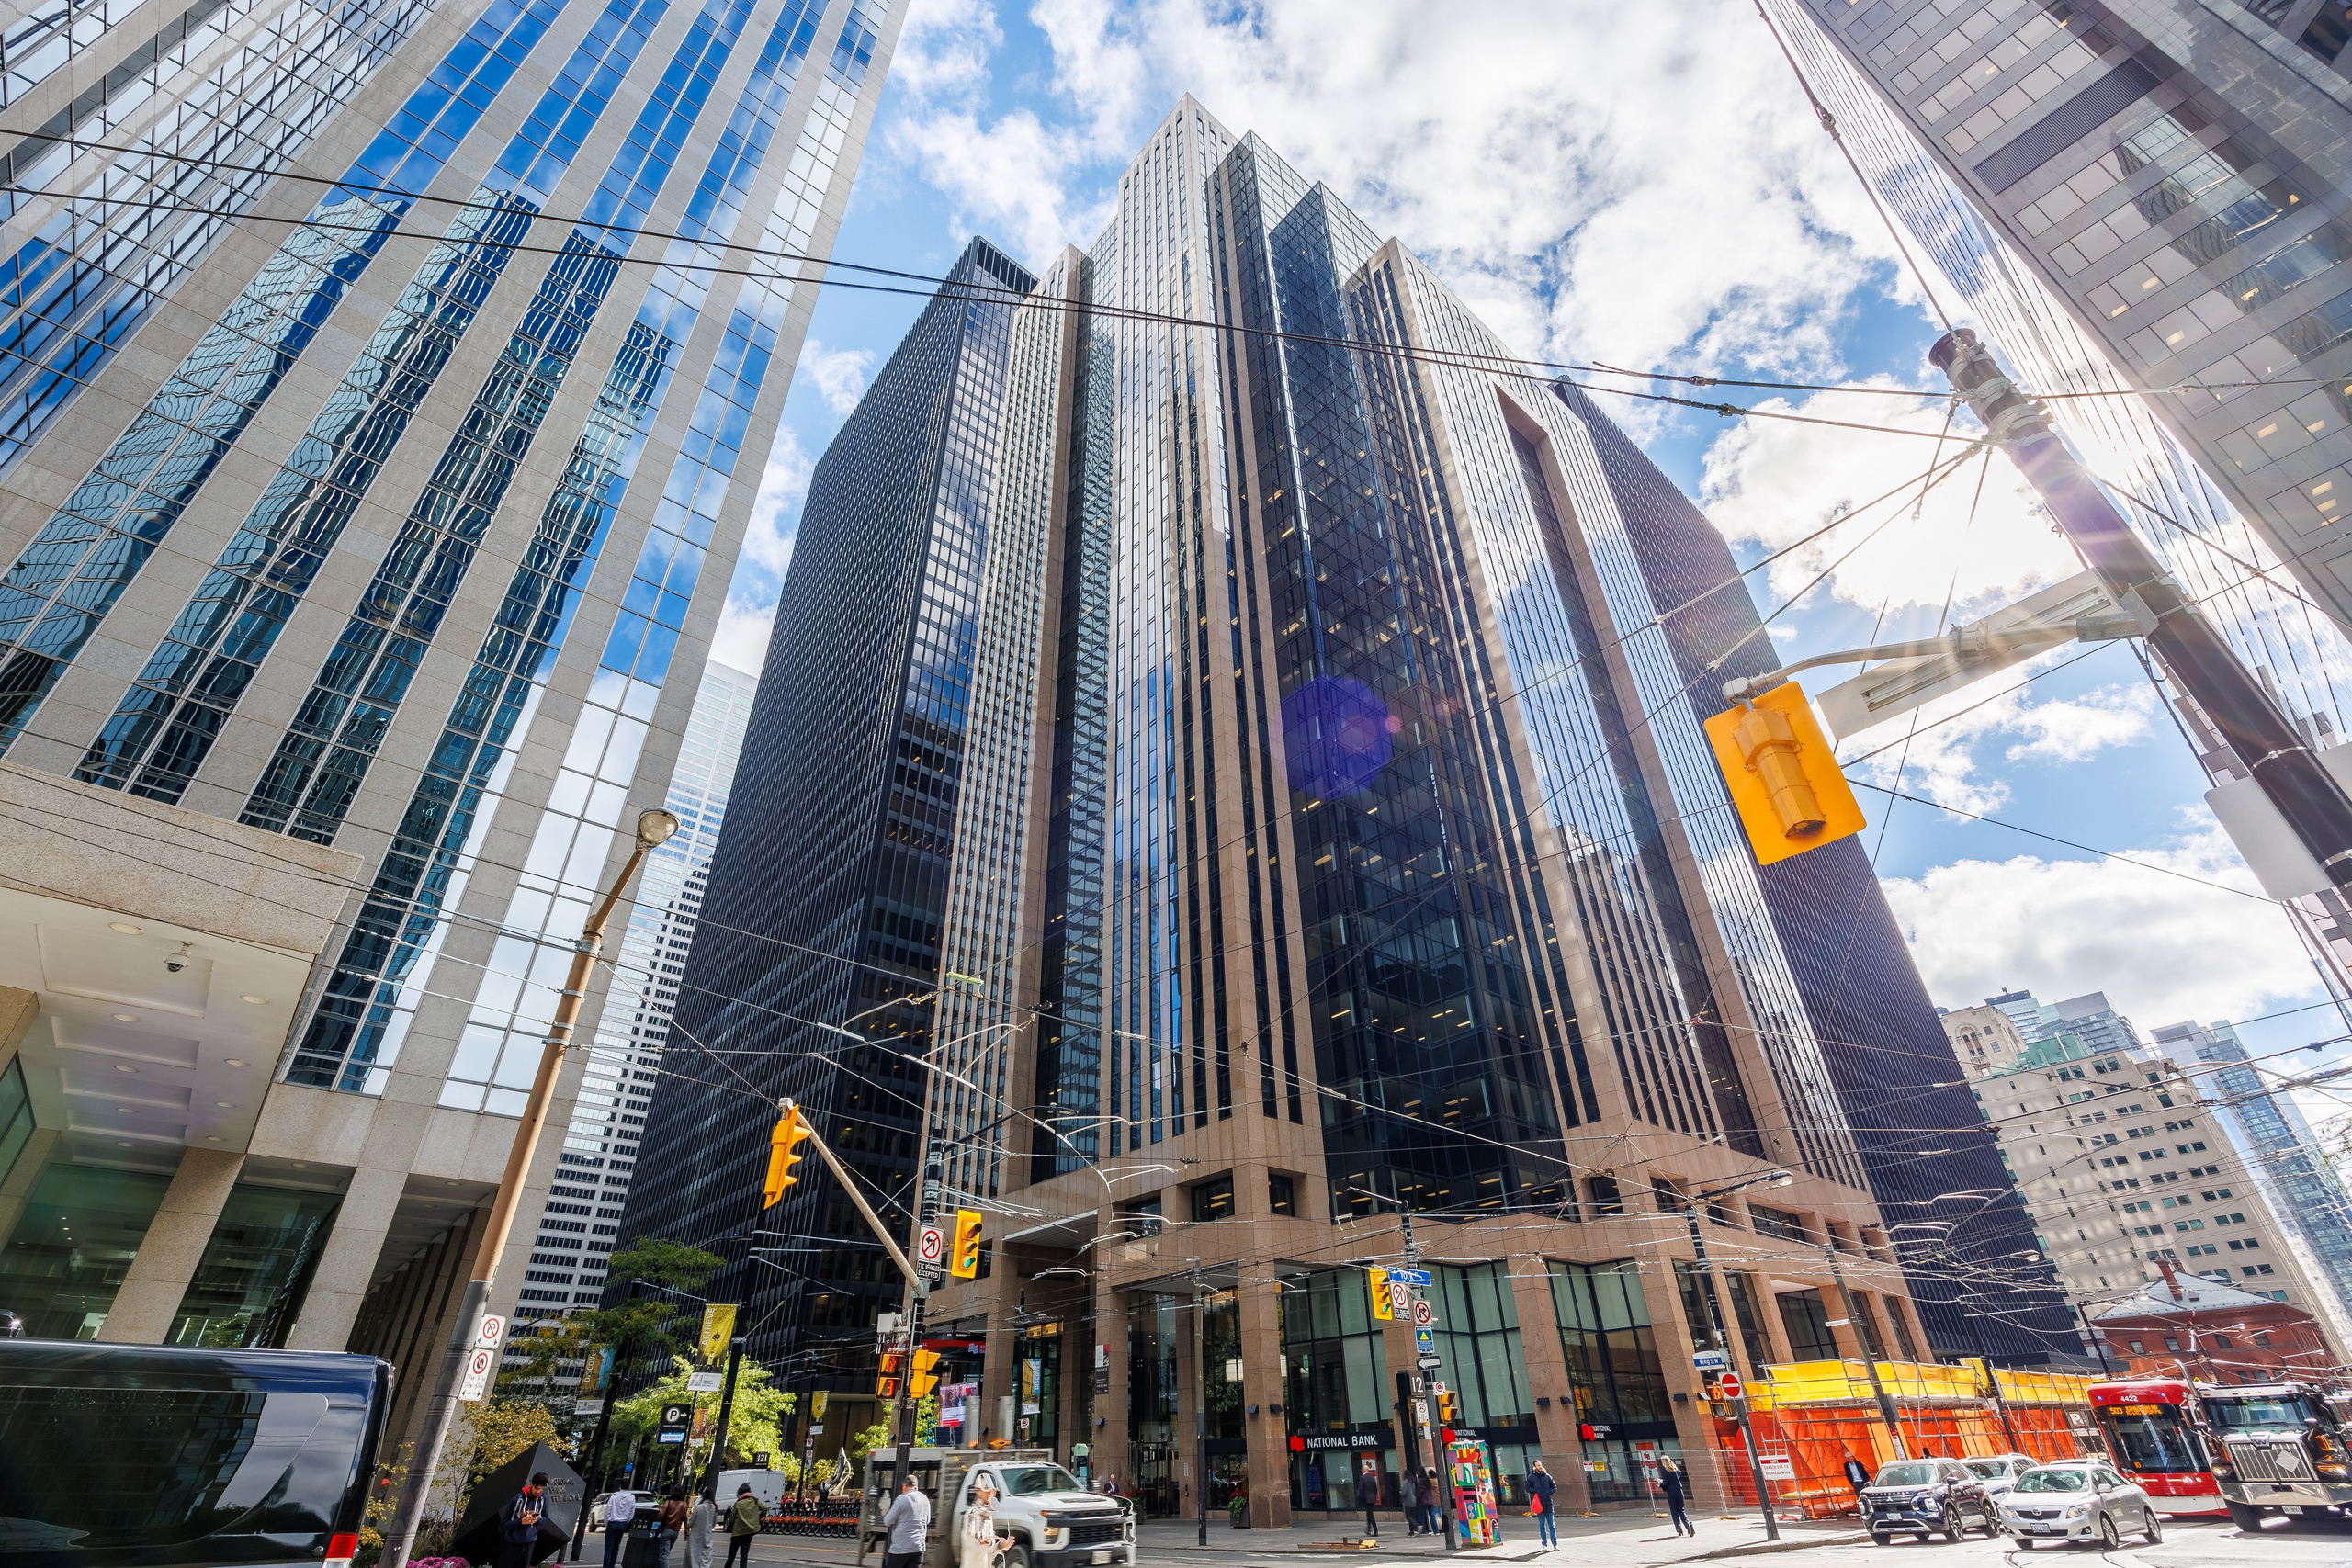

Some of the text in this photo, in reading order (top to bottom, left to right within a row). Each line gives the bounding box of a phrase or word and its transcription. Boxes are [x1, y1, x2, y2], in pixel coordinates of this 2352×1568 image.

[701, 1307, 715, 1346] ACHIEVE
[1306, 1435, 1378, 1449] NATIONAL BANK
